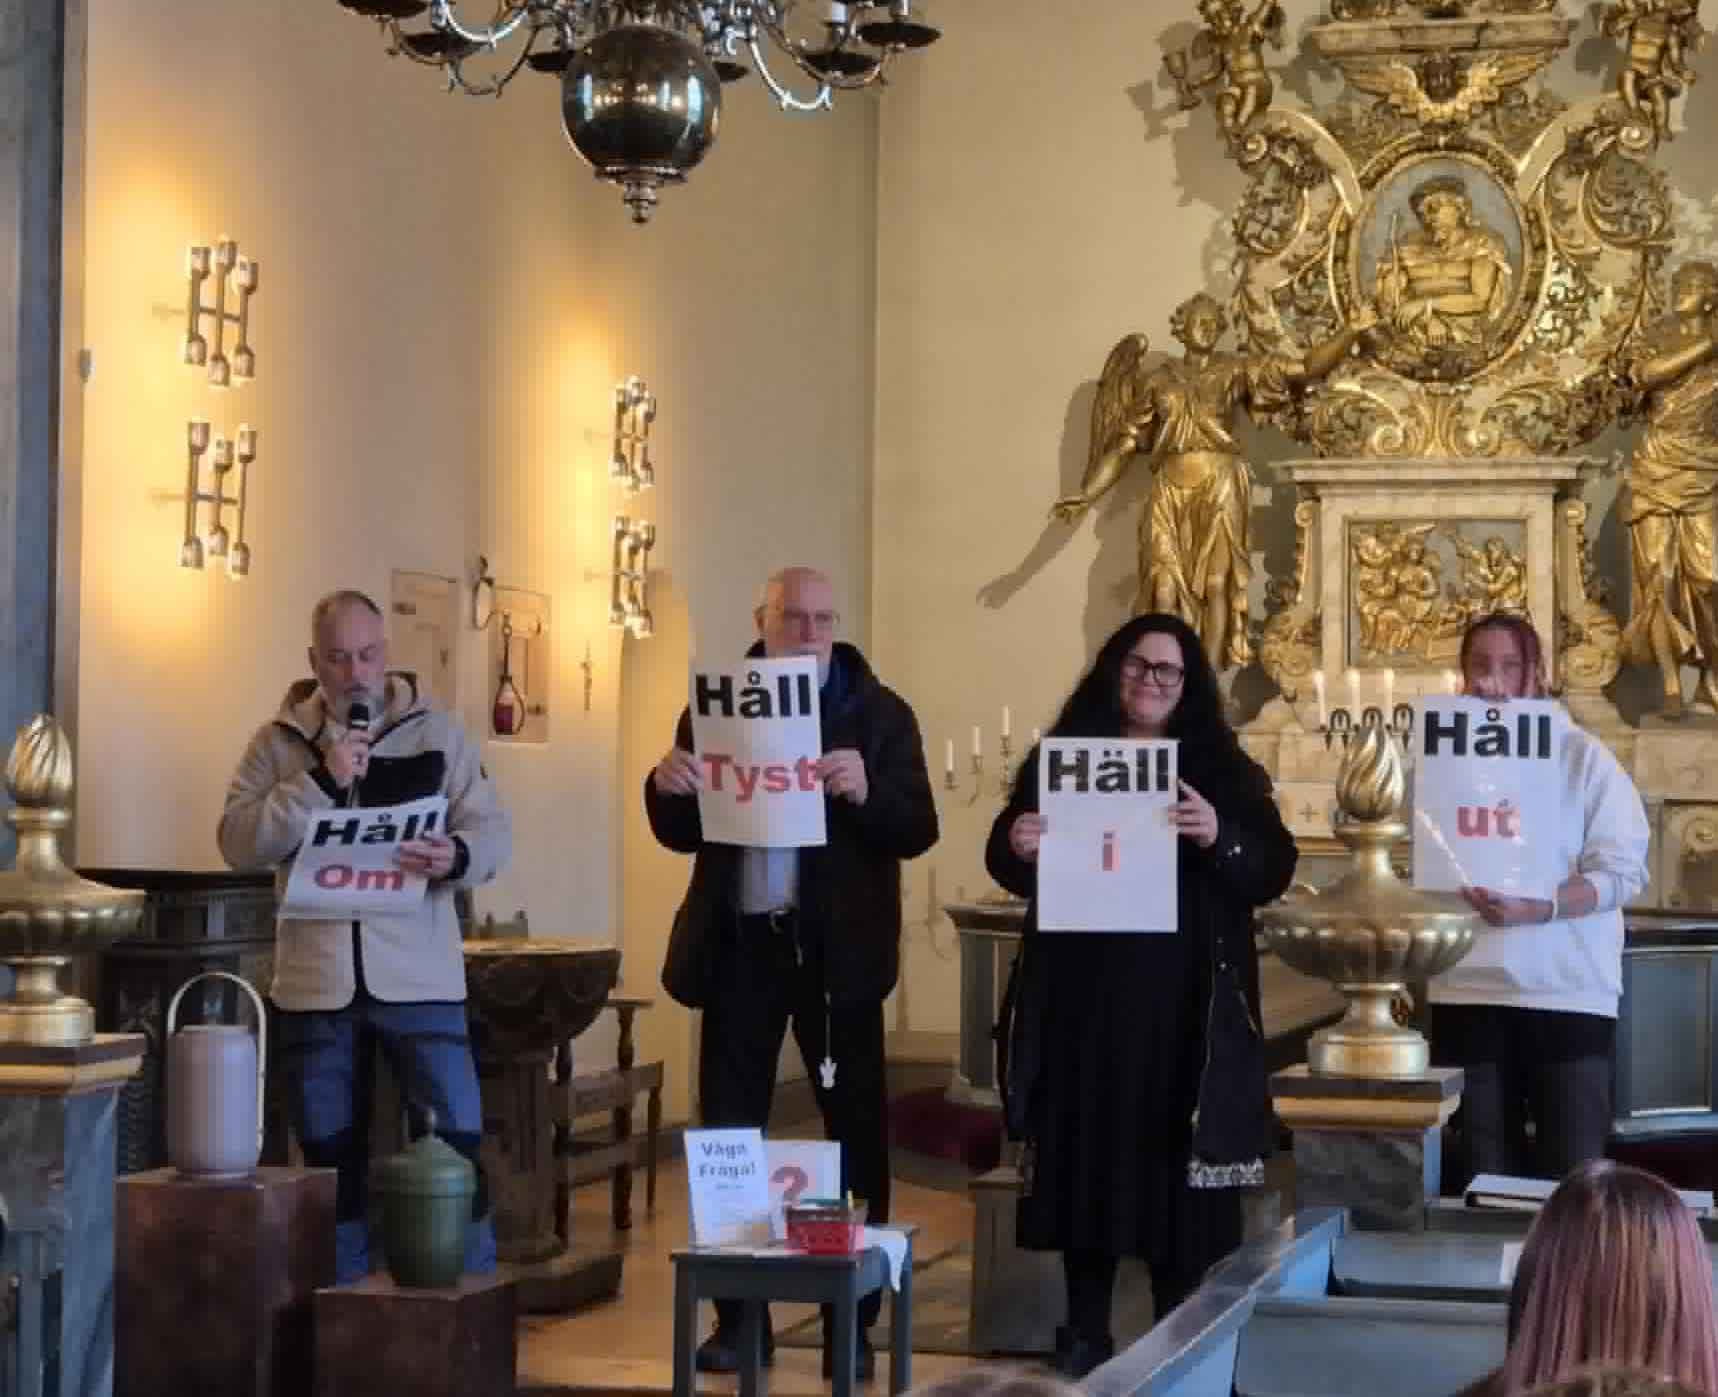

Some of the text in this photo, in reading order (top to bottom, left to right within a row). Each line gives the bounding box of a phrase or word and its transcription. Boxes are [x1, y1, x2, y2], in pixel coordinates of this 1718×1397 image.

[695, 670, 812, 718] Håll
[1424, 708, 1551, 759] Håll
[702, 753, 818, 803] Tyst
[1456, 800, 1515, 838] ut
[1102, 832, 1117, 872] i
[315, 864, 404, 891] Om
